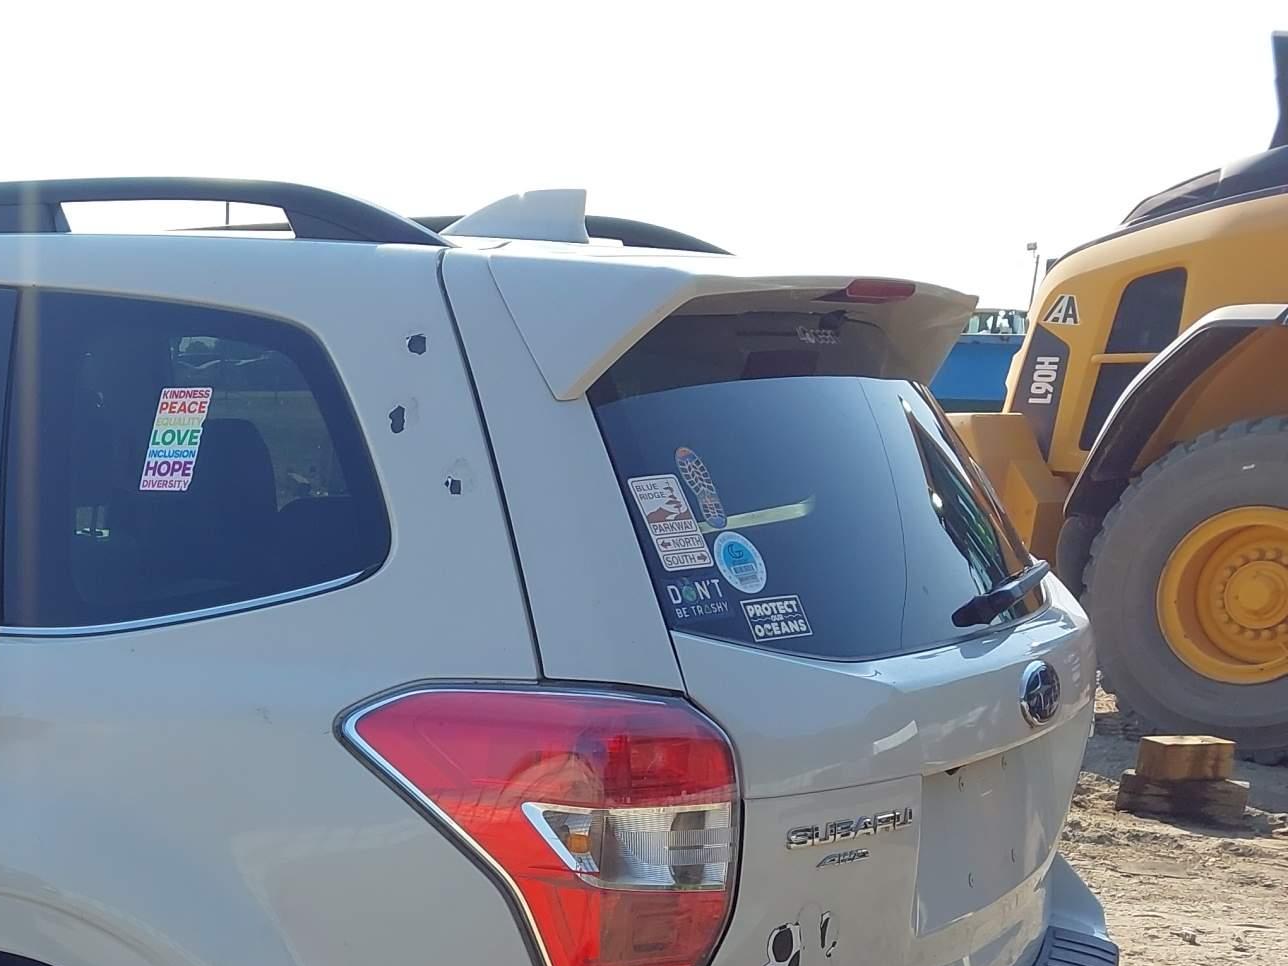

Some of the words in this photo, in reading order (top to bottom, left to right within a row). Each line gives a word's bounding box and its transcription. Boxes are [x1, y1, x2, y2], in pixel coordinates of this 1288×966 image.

[1028, 356, 1060, 404] L90H
[162, 389, 211, 399] KINDNESS
[159, 401, 208, 414] PEACE
[156, 417, 202, 426] EQUALITY
[152, 429, 200, 446] LOVE
[148, 449, 196, 458] INCLUSION
[144, 460, 193, 477] HOPE
[141, 479, 190, 488] DIVERSITY
[634, 482, 660, 493] BLUE
[639, 491, 667, 501] RIDGE
[652, 520, 693, 533] PARKWAY
[672, 536, 703, 548] NORTH
[665, 554, 697, 566] SOUTH
[666, 578, 723, 605] DON'T
[675, 607, 690, 619] BE
[746, 600, 799, 618] PROTECT
[770, 614, 785, 622] OUR
[754, 618, 808, 637] OCEANS
[786, 807, 913, 850] SUBARU
